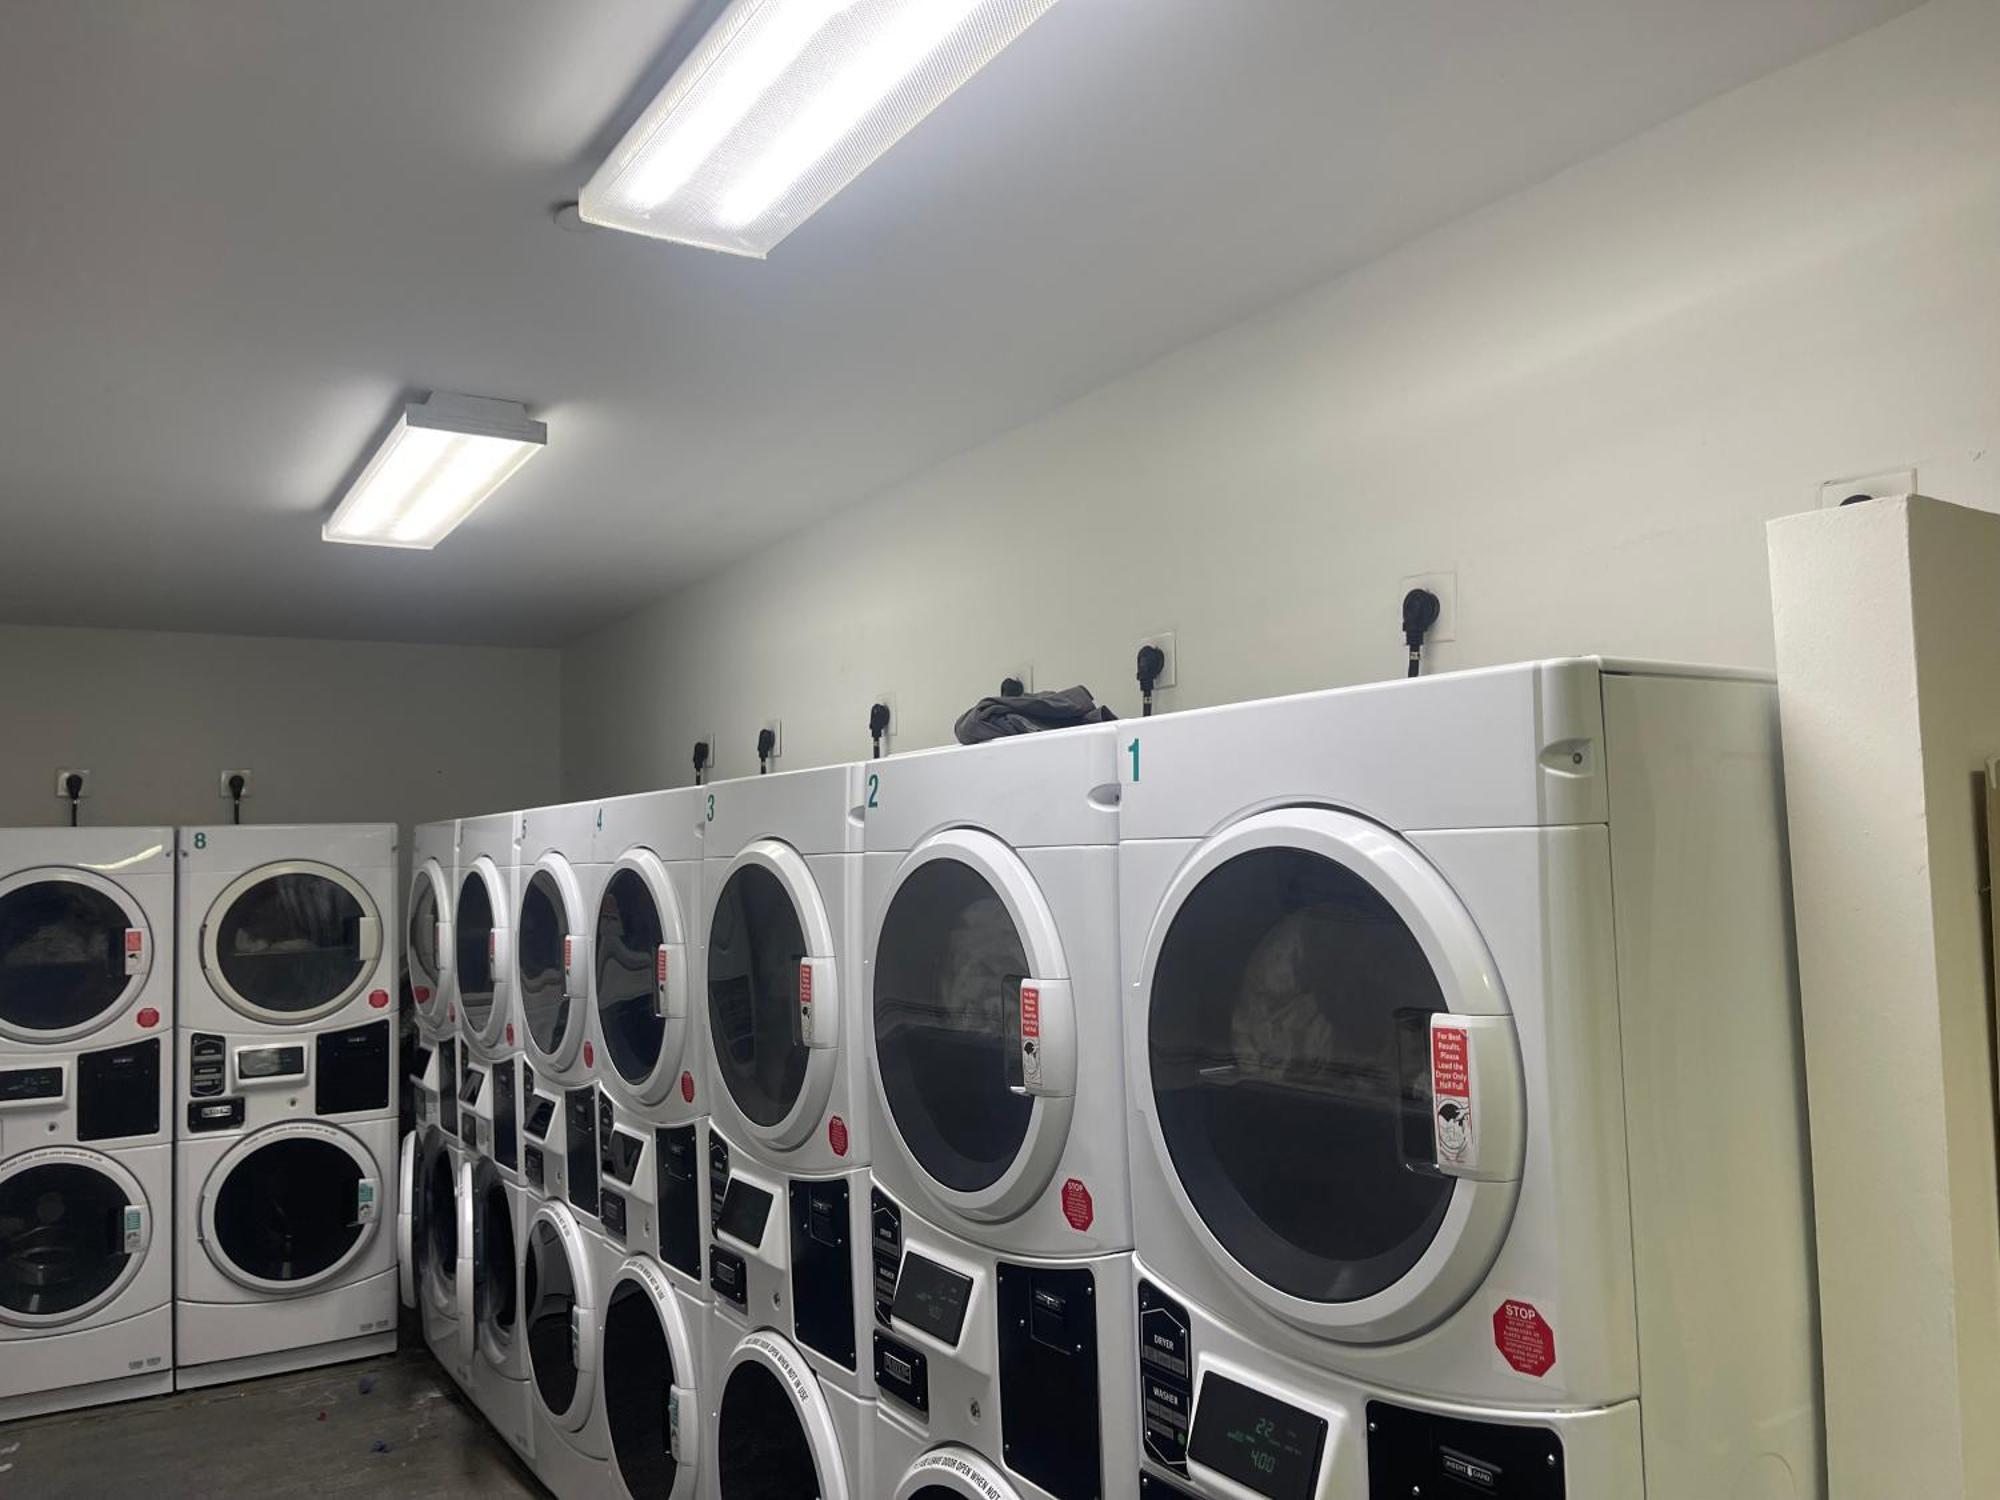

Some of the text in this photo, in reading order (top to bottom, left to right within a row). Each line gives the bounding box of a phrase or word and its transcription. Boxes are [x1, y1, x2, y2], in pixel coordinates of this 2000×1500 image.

[1128, 738, 1139, 781] 1
[868, 774, 879, 808] 2
[707, 794, 715, 822] 3
[597, 807, 602, 831] 4
[194, 831, 206, 850] 8
[1437, 1031, 1448, 1040] For
[1437, 1061, 1463, 1071] Load the
[1440, 1052, 1459, 1061] Please
[1436, 1071, 1467, 1083] Dryer Only
[1067, 1182, 1083, 1192] STOP
[1505, 1304, 1536, 1320] STOP
[1154, 1334, 1174, 1351] DRYER
[786, 1367, 798, 1381] NOT
[798, 1386, 809, 1402] USE
[1153, 1386, 1178, 1405] WASHER
[1256, 1418, 1274, 1438] 22
[941, 1456, 958, 1469] DOOR
[955, 1461, 972, 1477] OPEN
[970, 1469, 989, 1491] WHEN
[985, 1486, 1001, 1500] NOT
